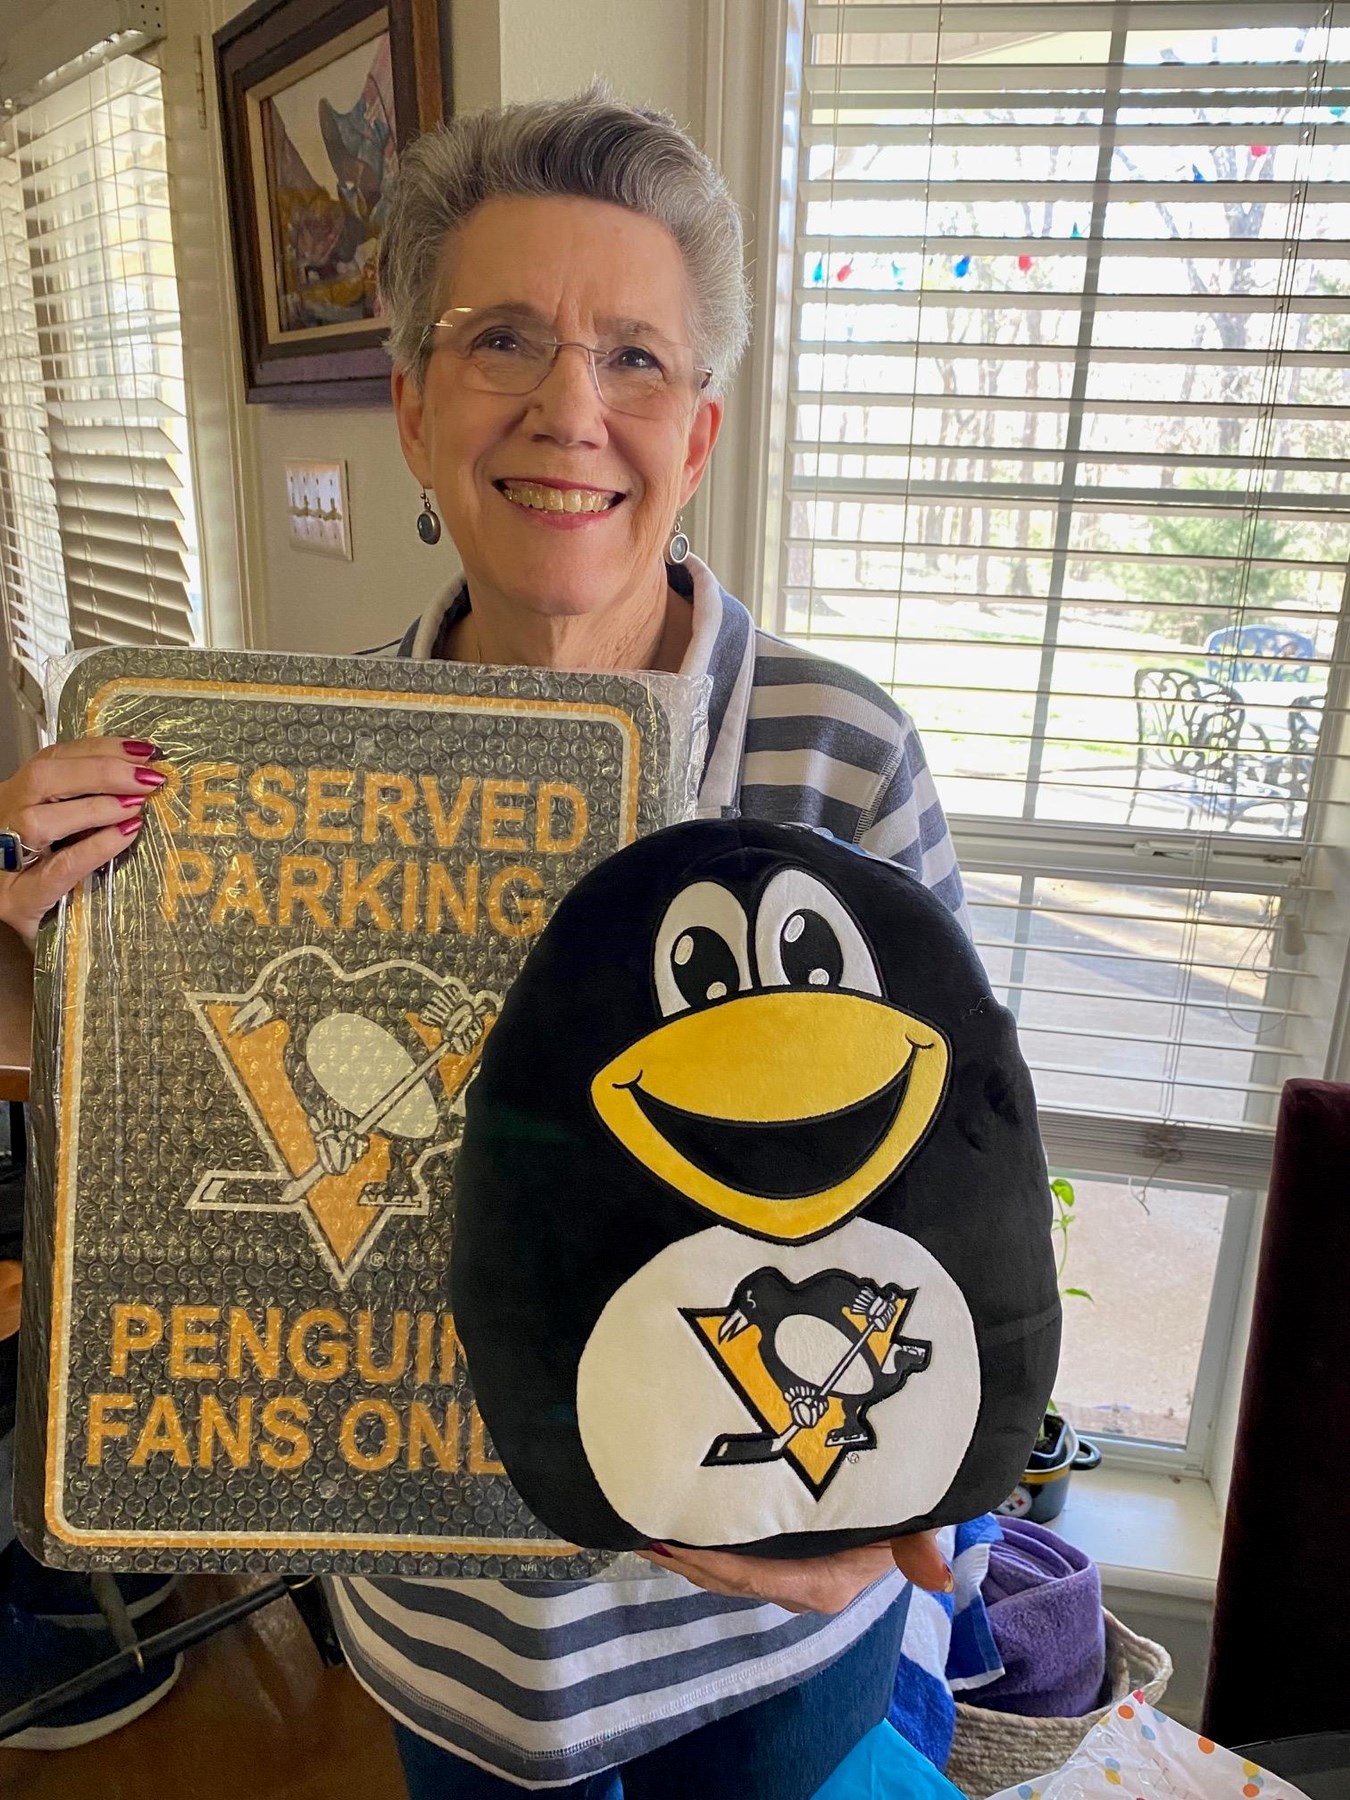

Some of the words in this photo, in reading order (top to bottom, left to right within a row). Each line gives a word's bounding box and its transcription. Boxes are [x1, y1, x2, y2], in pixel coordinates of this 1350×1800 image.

[162, 849, 546, 938] PARKING
[109, 1302, 468, 1386] PENGUI
[86, 1392, 311, 1471] FANS
[338, 1397, 506, 1476] ONL
